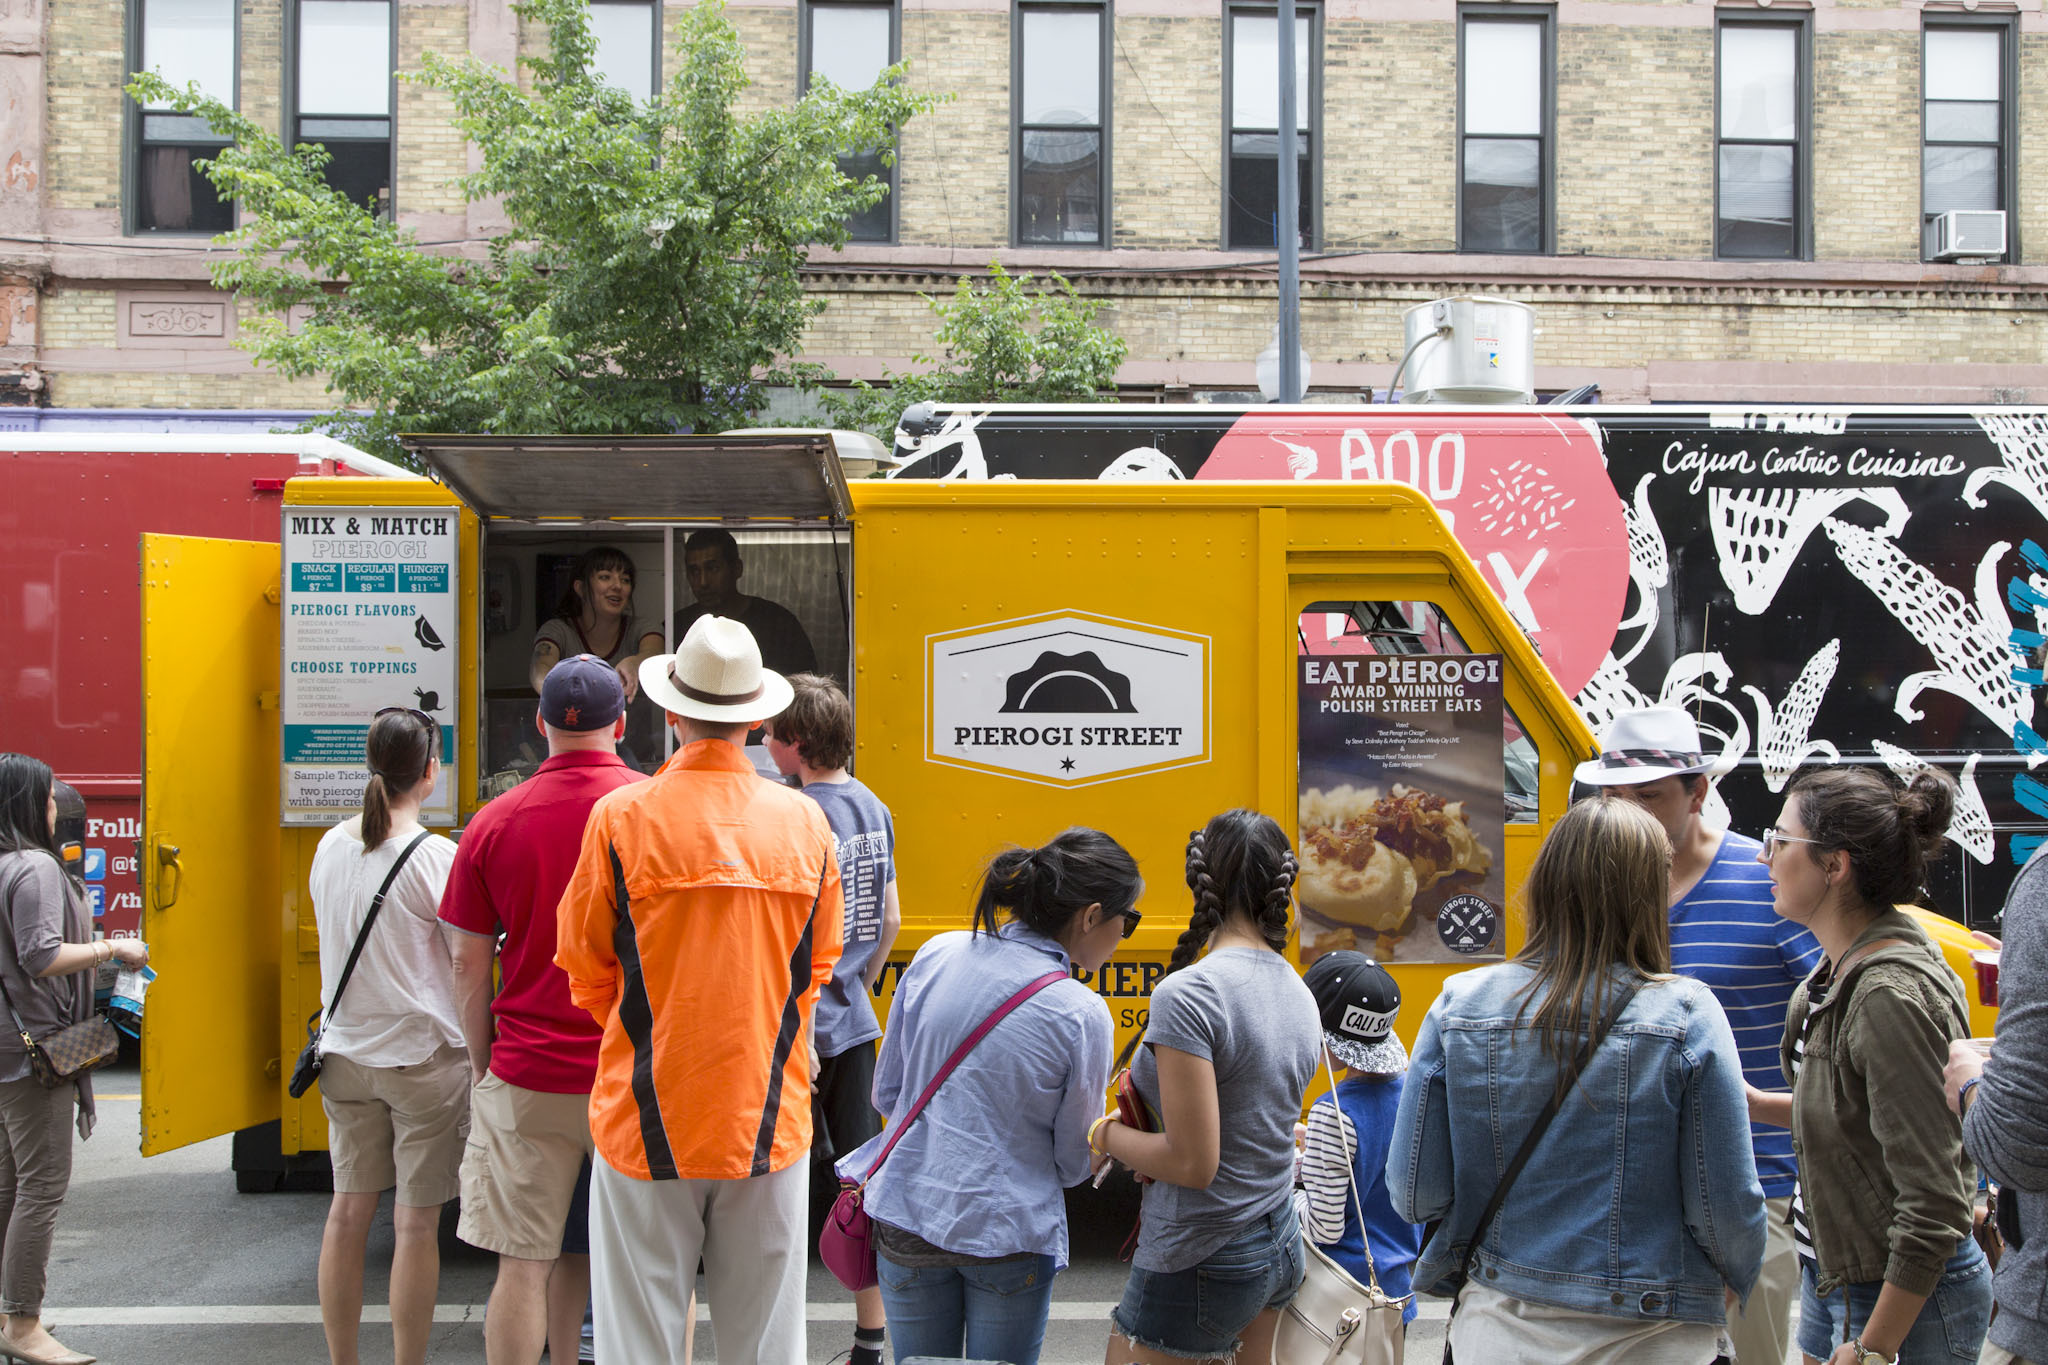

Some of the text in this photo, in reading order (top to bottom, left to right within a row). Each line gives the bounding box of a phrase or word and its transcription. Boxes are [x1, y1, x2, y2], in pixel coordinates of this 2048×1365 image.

[1662, 441, 1966, 494] Cajun Centric Cuisine
[291, 517, 448, 536] MIX & MATCH
[312, 540, 427, 558] PIEROGI
[301, 564, 337, 573] SNACK
[347, 564, 395, 574] REGULAR
[403, 565, 446, 574] HUNGRY
[309, 583, 320, 592] $7
[360, 583, 372, 592] $9
[411, 583, 427, 592] $11
[291, 604, 417, 617] PIEROGI FLAVORS
[291, 661, 417, 674] CHOOSE TOPPINGS
[1305, 660, 1499, 684] EAT PIEROGI
[1330, 684, 1465, 698] AWARD WINNING
[1320, 699, 1482, 713] POLISH STREET EATS
[954, 727, 1182, 746] PIEROGI STREET
[294, 771, 335, 782] Sample
[300, 786, 364, 798] two pierogi
[288, 797, 312, 806] with
[1440, 897, 1494, 920] PIEROGI STREET
[1345, 1011, 1375, 1032] CALI
